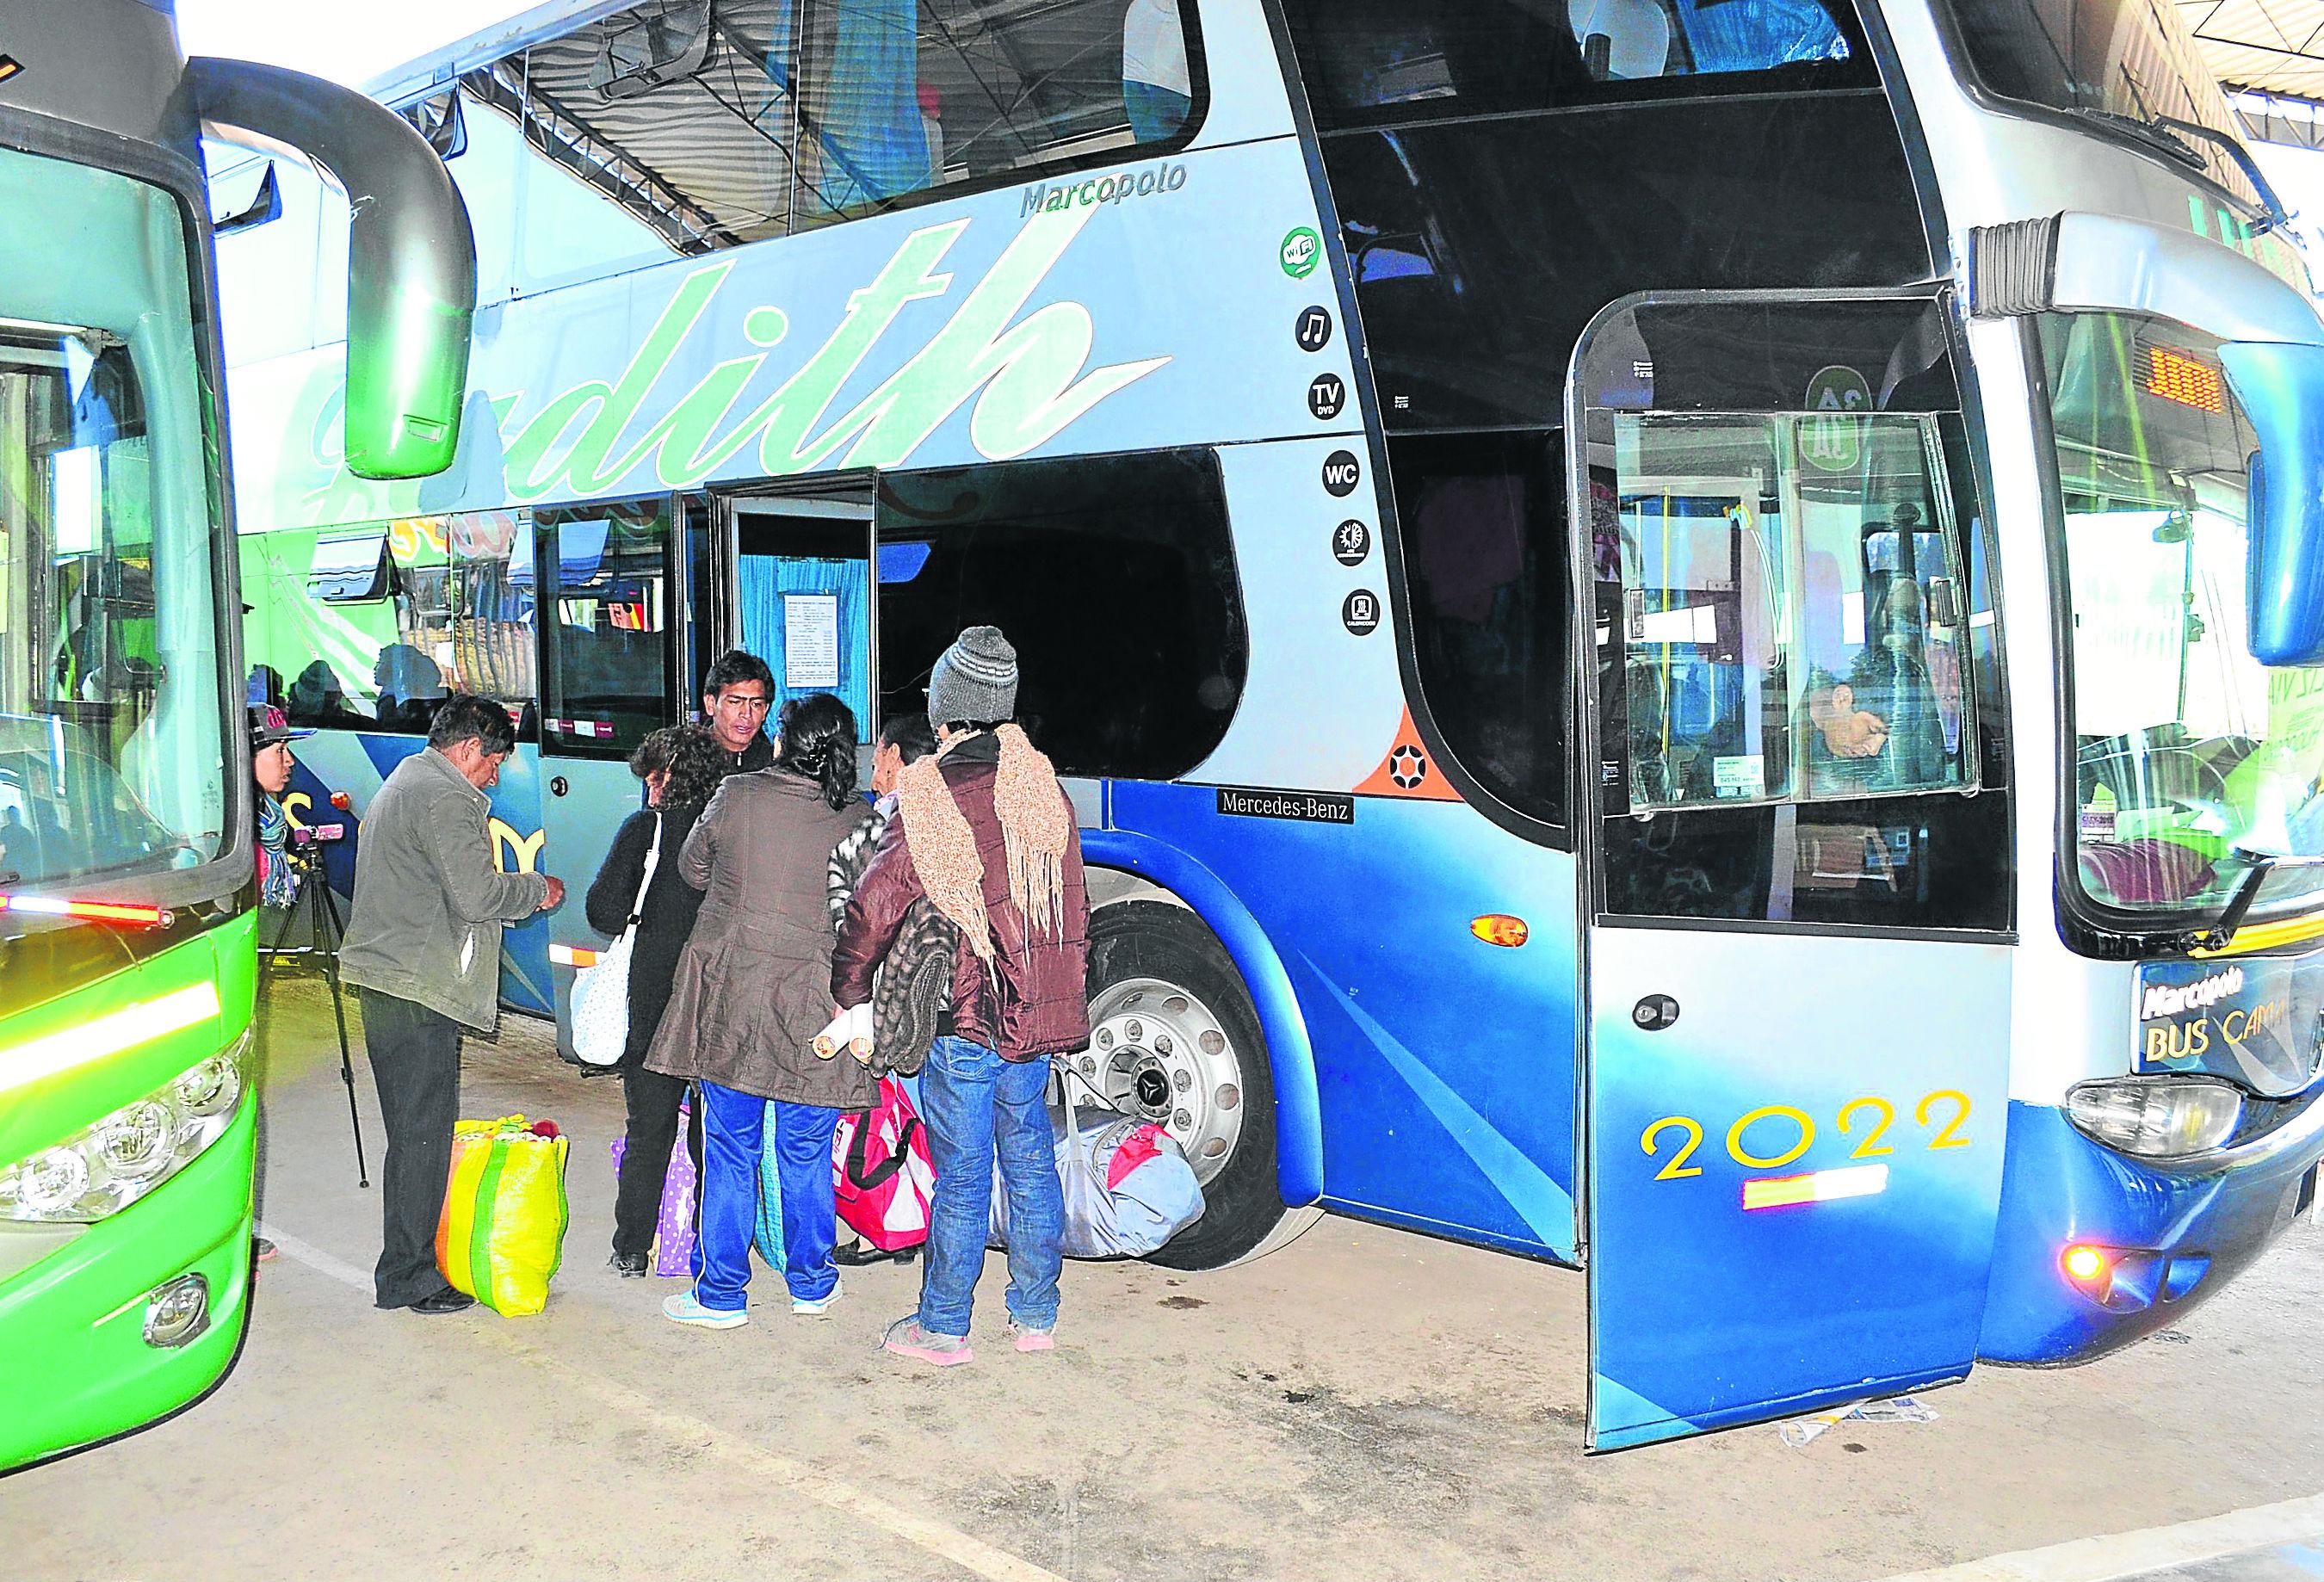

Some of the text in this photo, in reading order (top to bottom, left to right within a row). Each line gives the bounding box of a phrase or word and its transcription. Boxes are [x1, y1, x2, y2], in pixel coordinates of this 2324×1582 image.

[1019, 162, 1187, 219] Marcopolo
[303, 174, 1172, 514] dith
[1313, 382, 1340, 405] TV
[1317, 405, 1334, 415] DVD
[1326, 464, 1357, 485] WC
[1222, 792, 1348, 820] Mercedes-Benz
[2142, 966, 2243, 1021] Marcopolo
[2147, 1018, 2210, 1062] BUS
[1641, 1090, 1971, 1180] 2022
